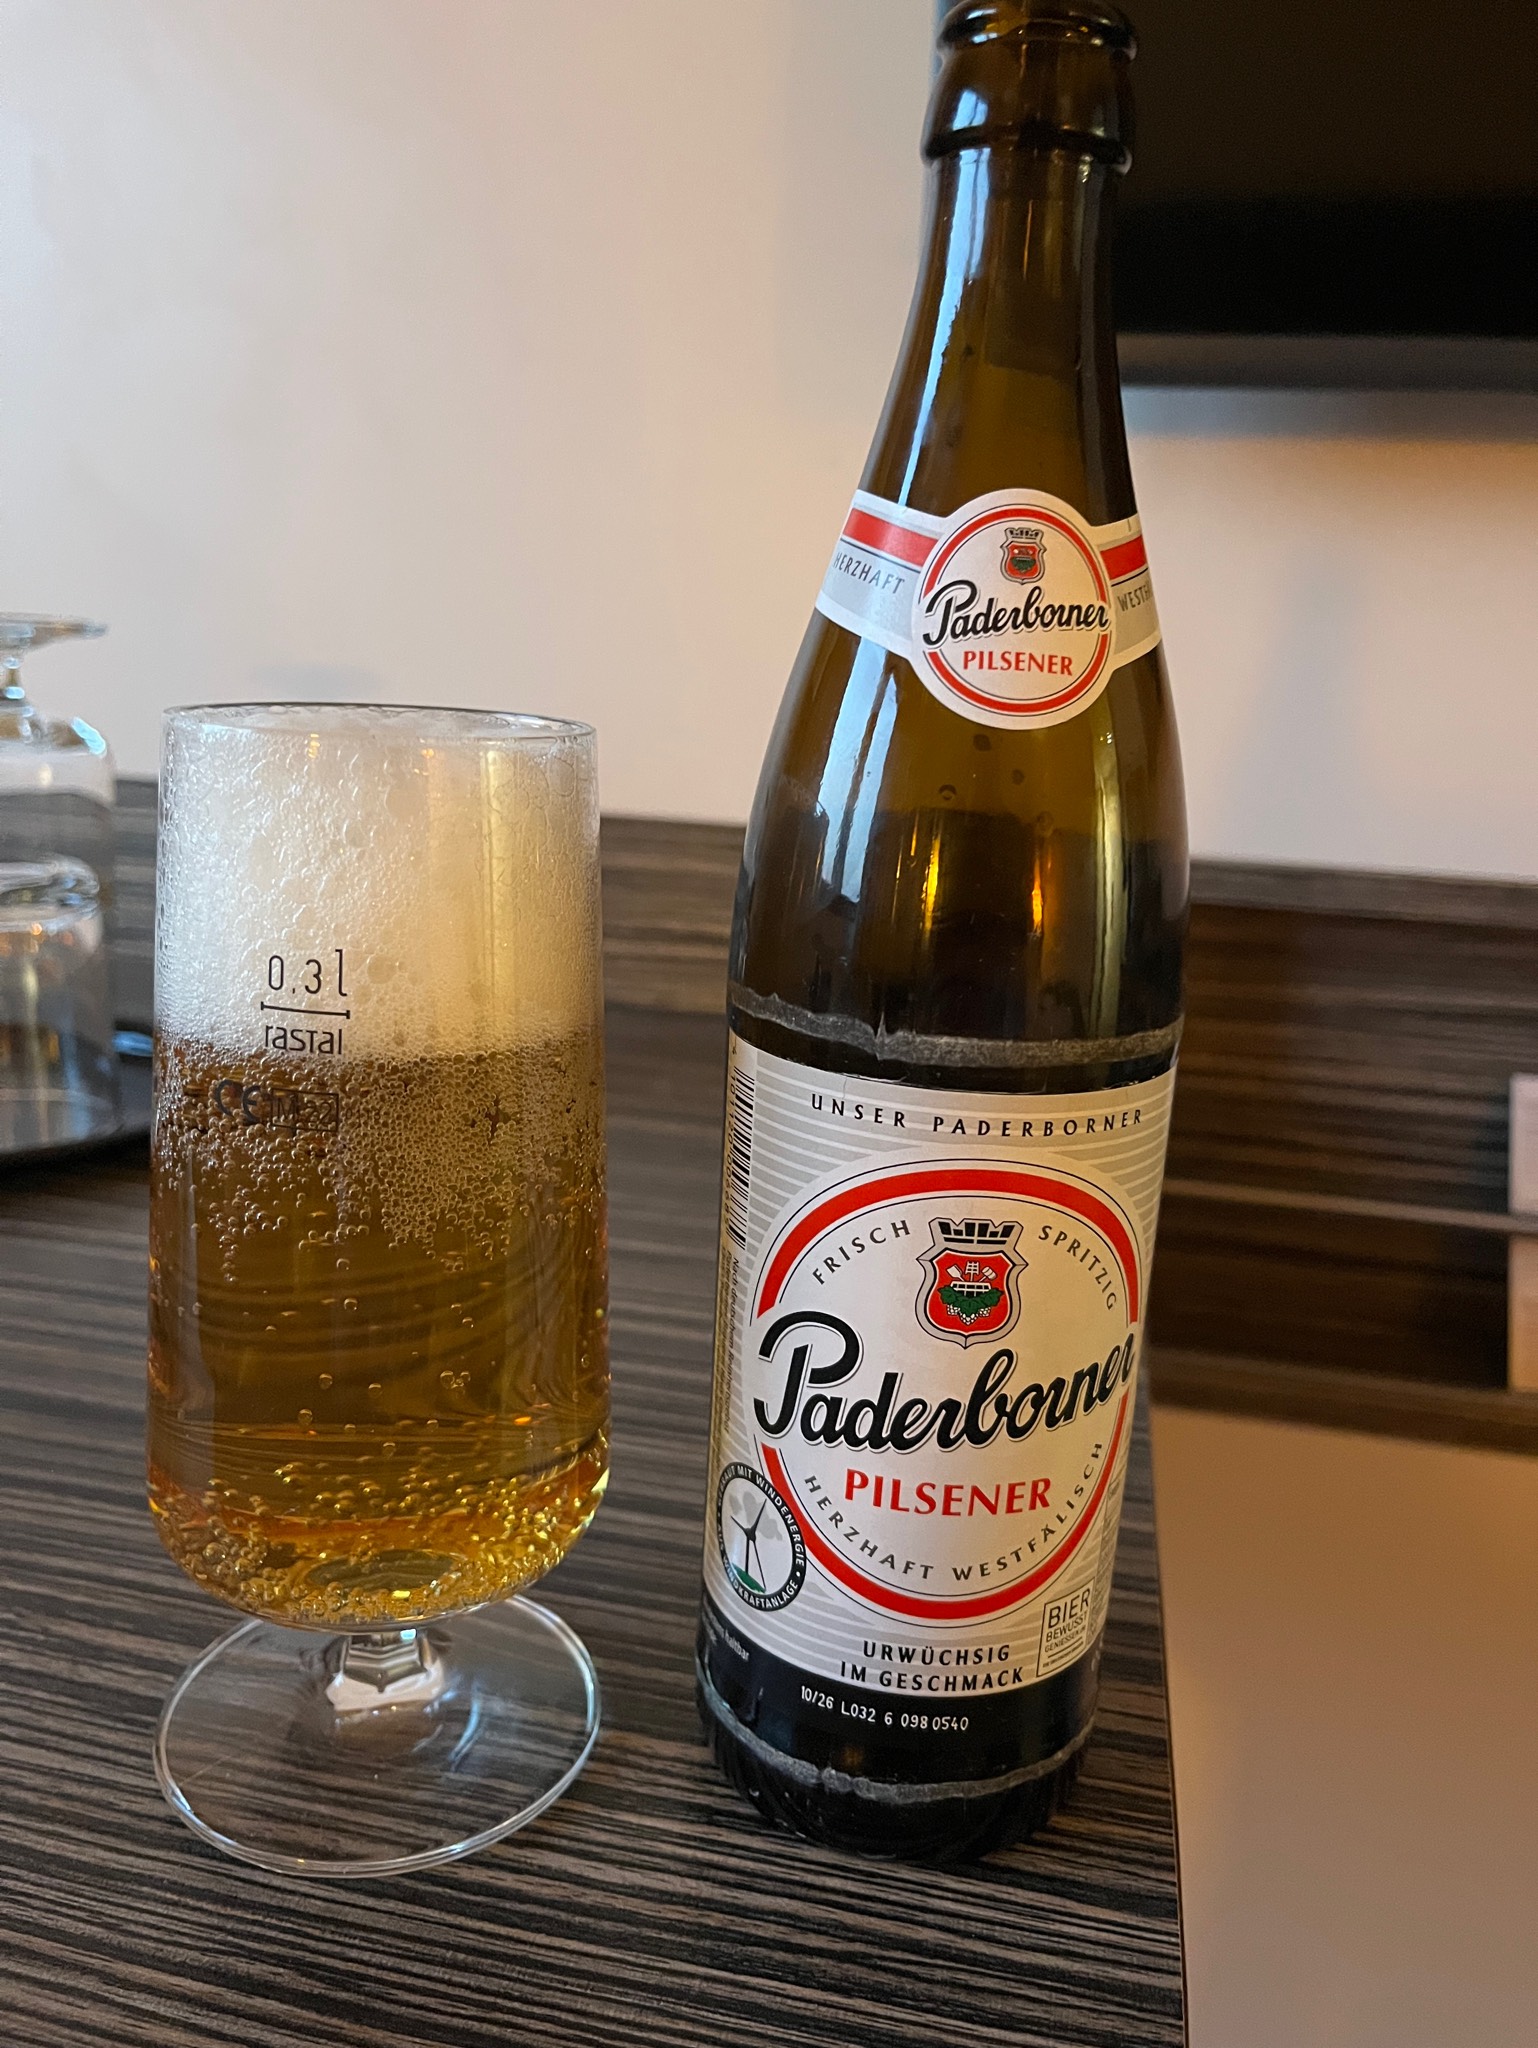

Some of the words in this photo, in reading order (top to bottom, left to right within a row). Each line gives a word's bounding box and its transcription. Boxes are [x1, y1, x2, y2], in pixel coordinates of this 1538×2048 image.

[833, 552, 906, 595] HERZHAFT
[922, 579, 1110, 646] Paderborner
[1117, 583, 1152, 612] WESTF
[963, 650, 1073, 677] PILSENER
[264, 1024, 344, 1055] rastal
[811, 1093, 907, 1129] UNSER
[933, 1108, 1143, 1138] PADERBORNER
[812, 1219, 911, 1286] FRISCH
[1037, 1225, 1118, 1311] SPRITZIG
[753, 1310, 1134, 1452] Paderborner
[804, 1476, 934, 1580] HERZHAFT
[952, 1442, 1103, 1581] WESTFÄLISCH
[845, 1468, 1052, 1517] PILSENER
[737, 1465, 752, 1479] MIT
[756, 1474, 805, 1567] WINDENERGIE
[723, 1558, 798, 1609] WINDKRAFTANLAGE
[1045, 1609, 1088, 1643] BEWUSST
[1047, 1587, 1091, 1629] BIER
[863, 1640, 1010, 1666] URWÜCHSIG
[841, 1660, 867, 1682] IM
[879, 1666, 1023, 1692] GESCHMACK
[801, 1685, 834, 1710] 10/26
[884, 1711, 893, 1726] 6
[901, 1713, 928, 1730] 098
[931, 1716, 969, 1731] 0540
